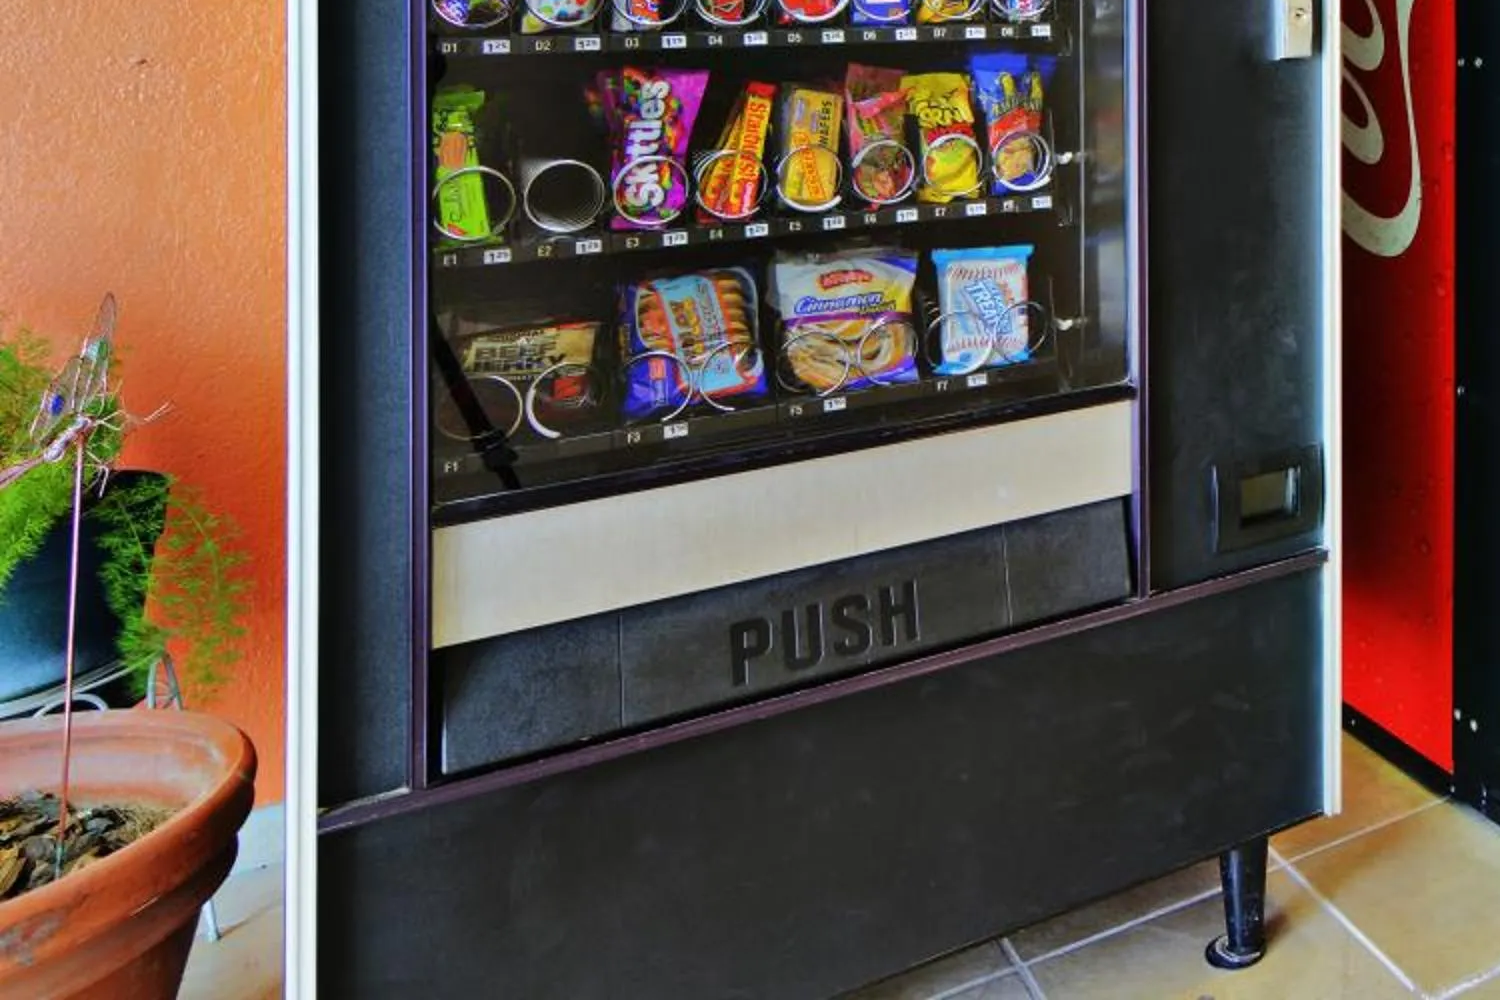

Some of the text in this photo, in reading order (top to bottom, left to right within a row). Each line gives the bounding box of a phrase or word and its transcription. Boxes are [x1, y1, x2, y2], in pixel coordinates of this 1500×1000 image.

[442, 43, 457, 53] D1
[535, 40, 551, 51] D2
[625, 38, 640, 48] D3
[625, 80, 671, 206] Skittles
[794, 292, 883, 314] Cinnamon
[729, 578, 921, 687] PUSH
